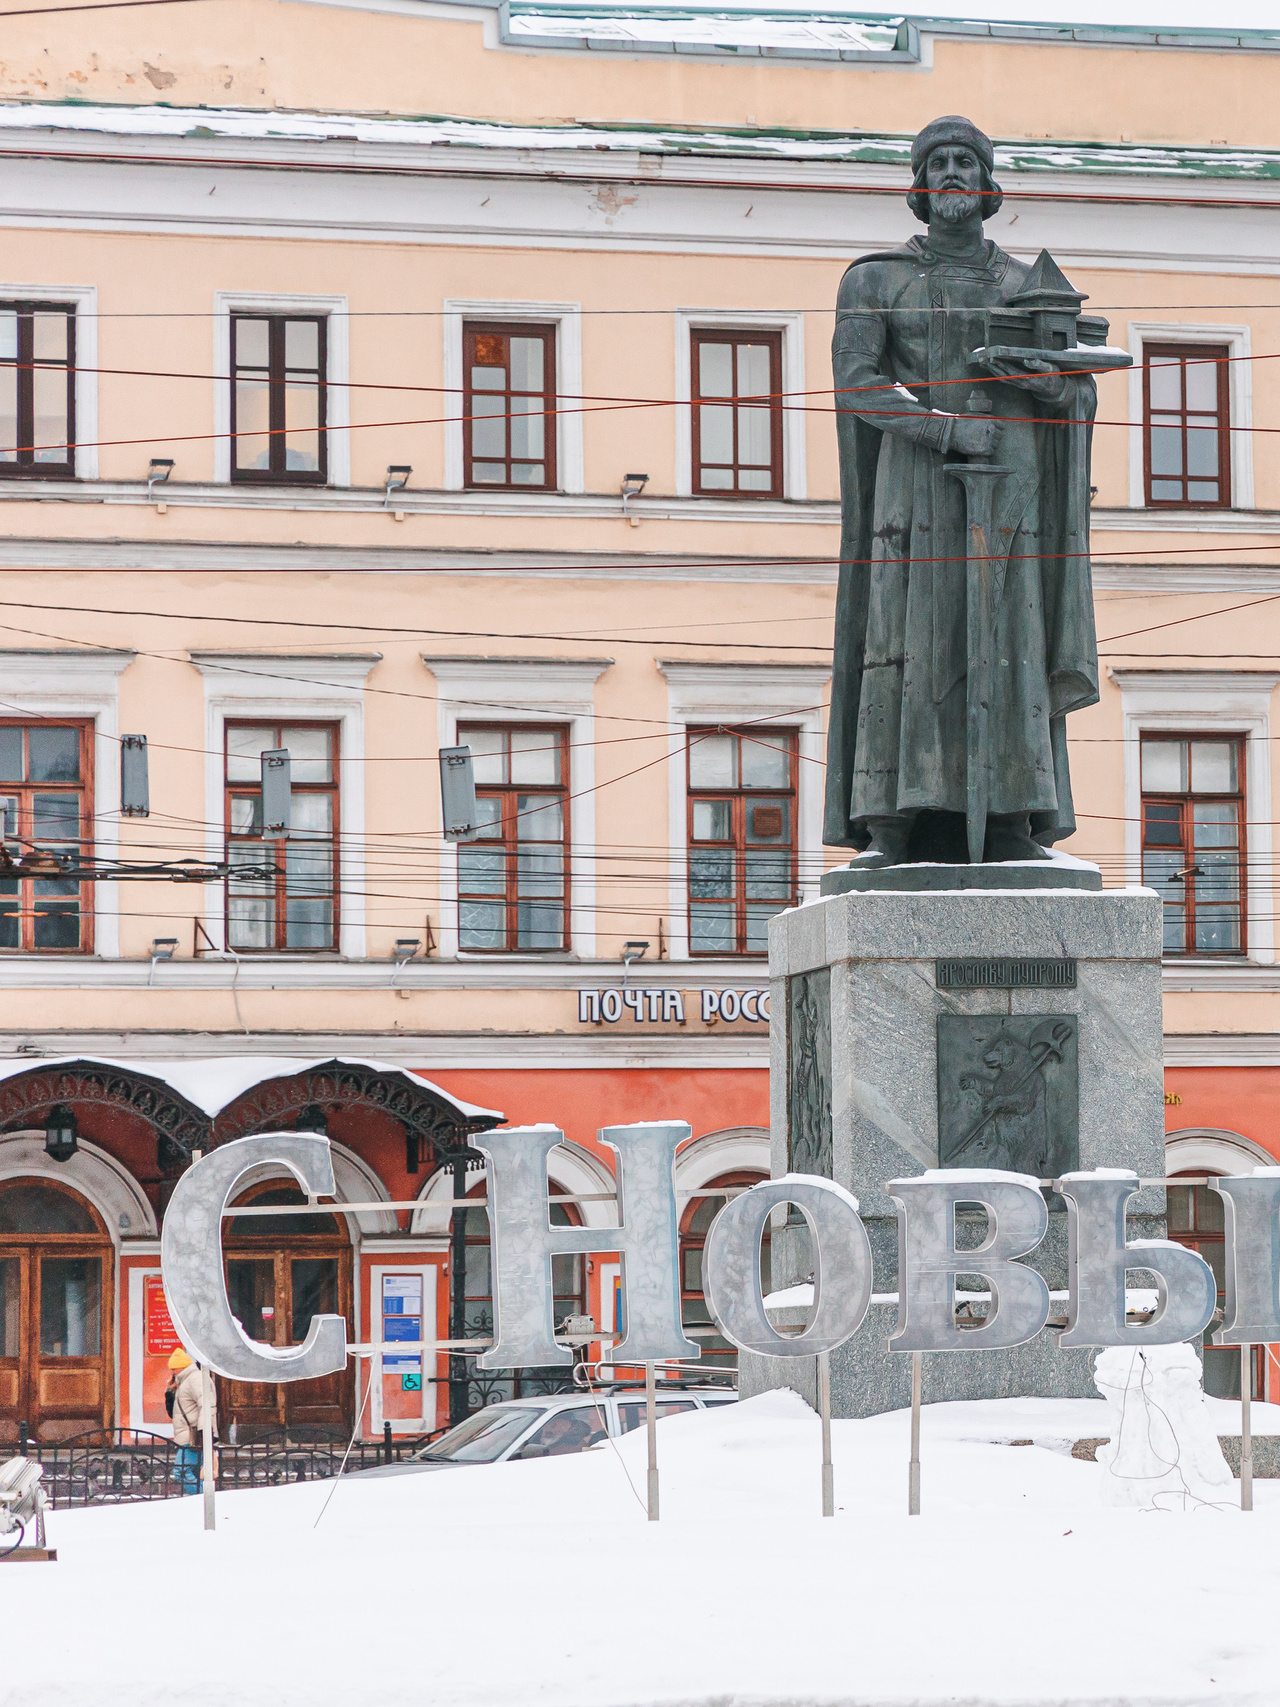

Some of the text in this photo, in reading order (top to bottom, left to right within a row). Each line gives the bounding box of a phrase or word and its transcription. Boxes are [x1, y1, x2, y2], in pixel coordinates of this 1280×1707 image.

[940, 961, 1075, 985] ЯРОСЛАВУ МУДРОМУ
[579, 989, 685, 1022] ПОЧТА
[161, 1132, 346, 1382] С
